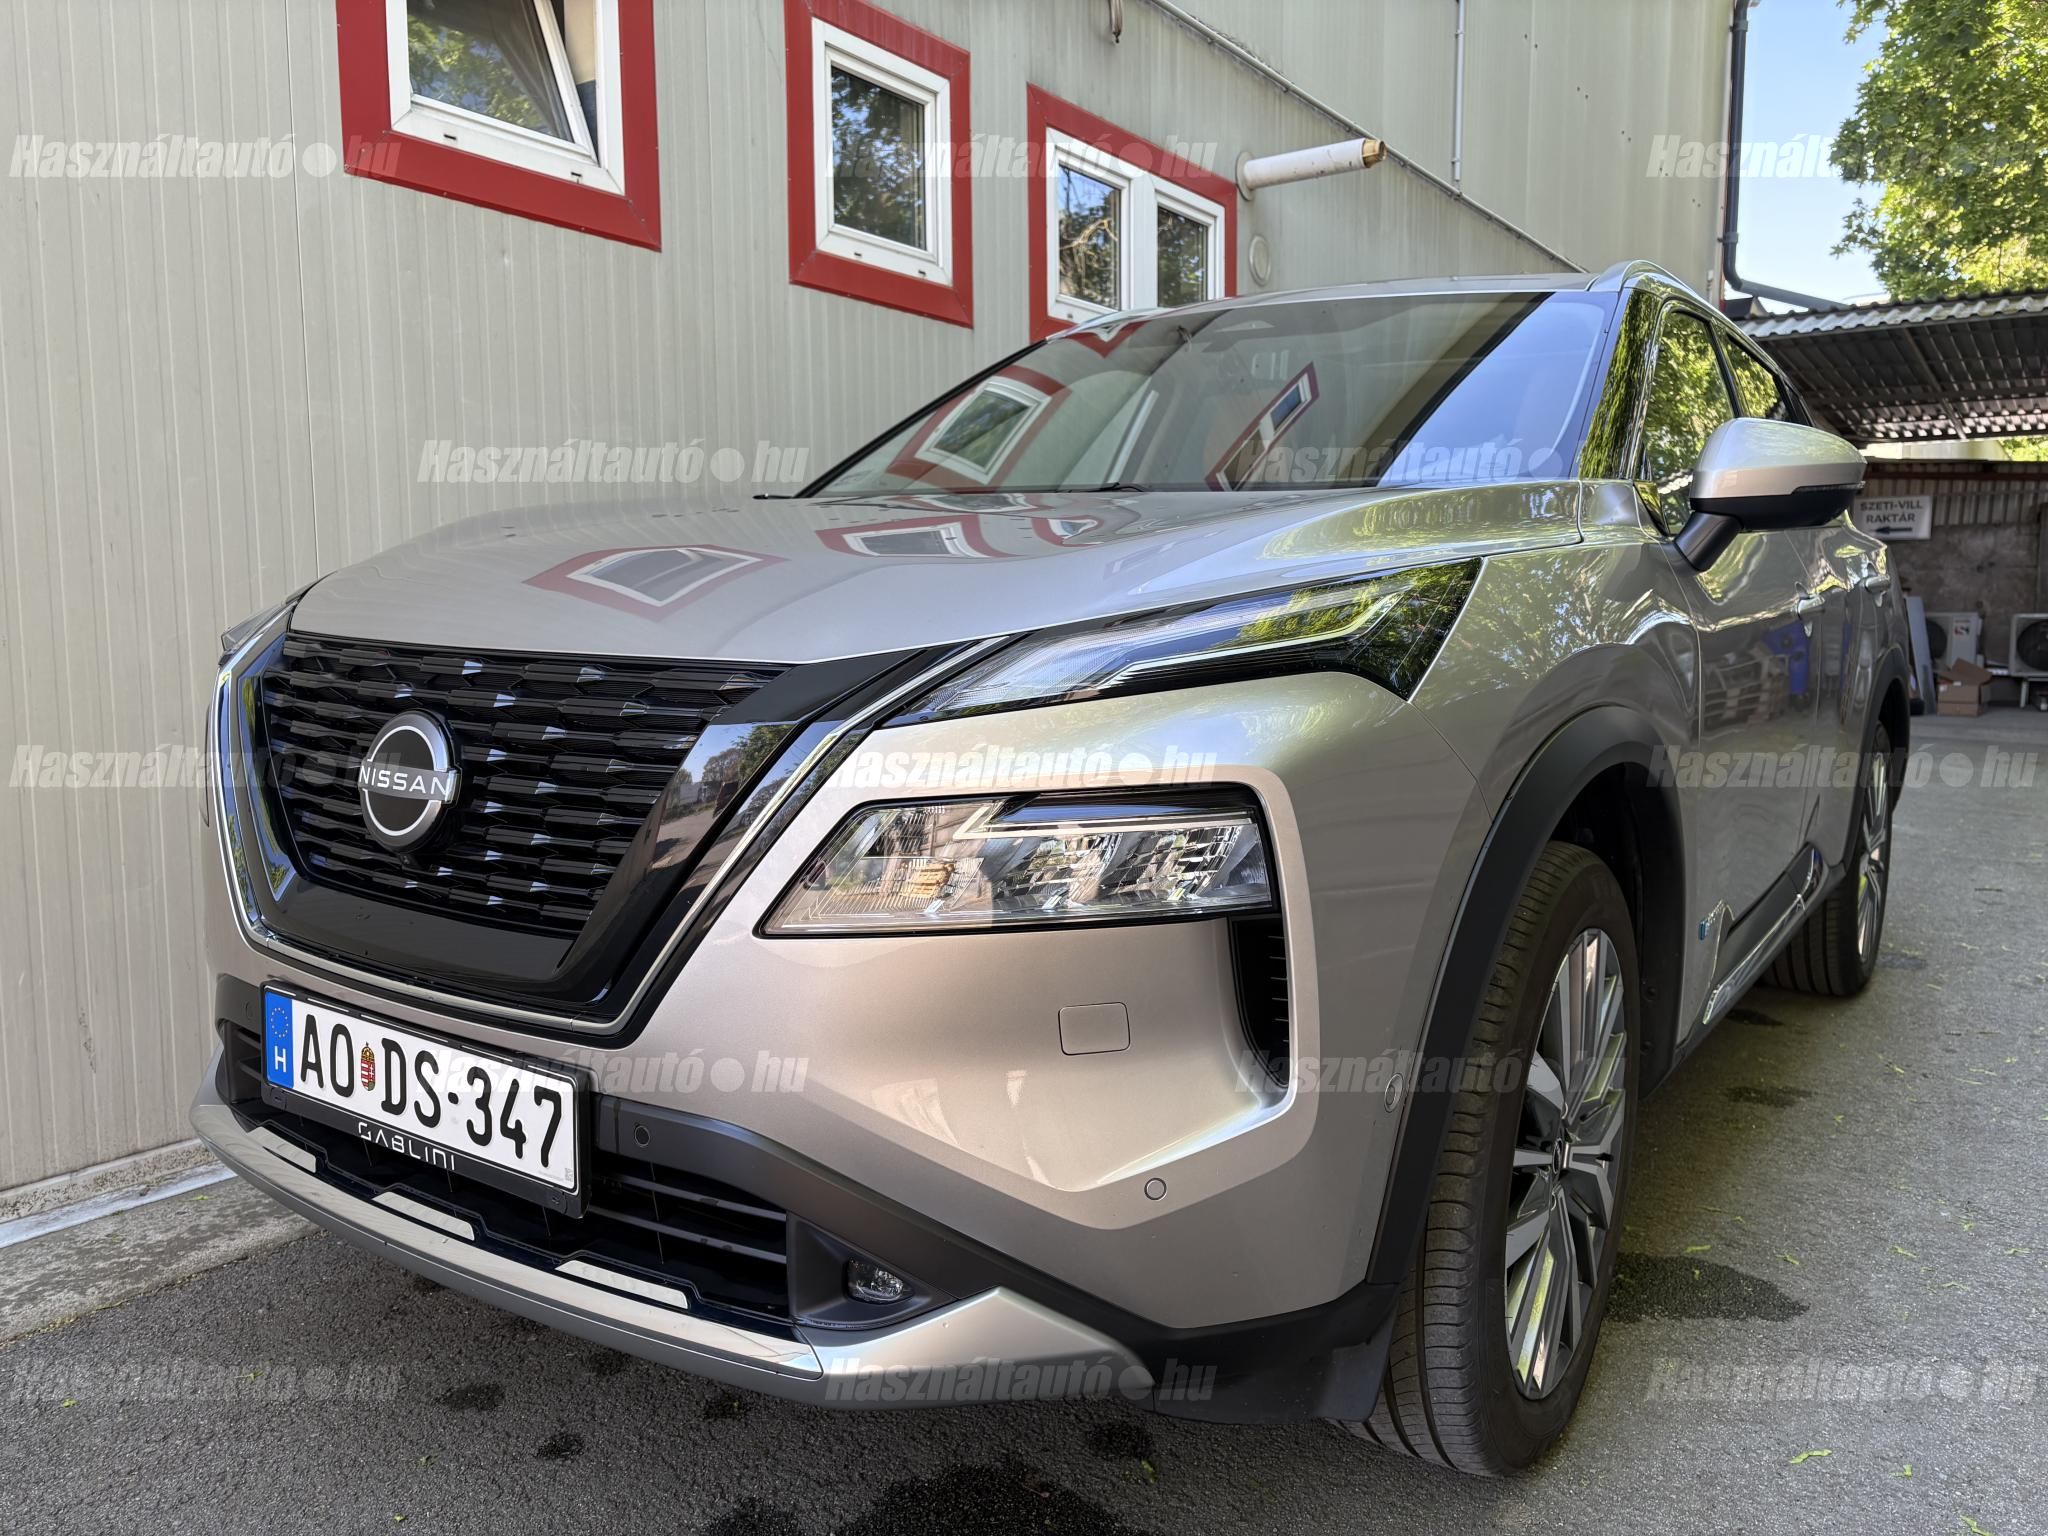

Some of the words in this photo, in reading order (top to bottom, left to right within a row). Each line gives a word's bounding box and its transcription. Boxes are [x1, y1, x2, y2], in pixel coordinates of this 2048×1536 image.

[1861, 501, 1923, 512] SZETI-VILL
[1866, 512, 1916, 524] RAKTÁR
[359, 765, 452, 803] NISSAN
[274, 1045, 287, 1073] H
[358, 1122, 456, 1171] GABLINI
